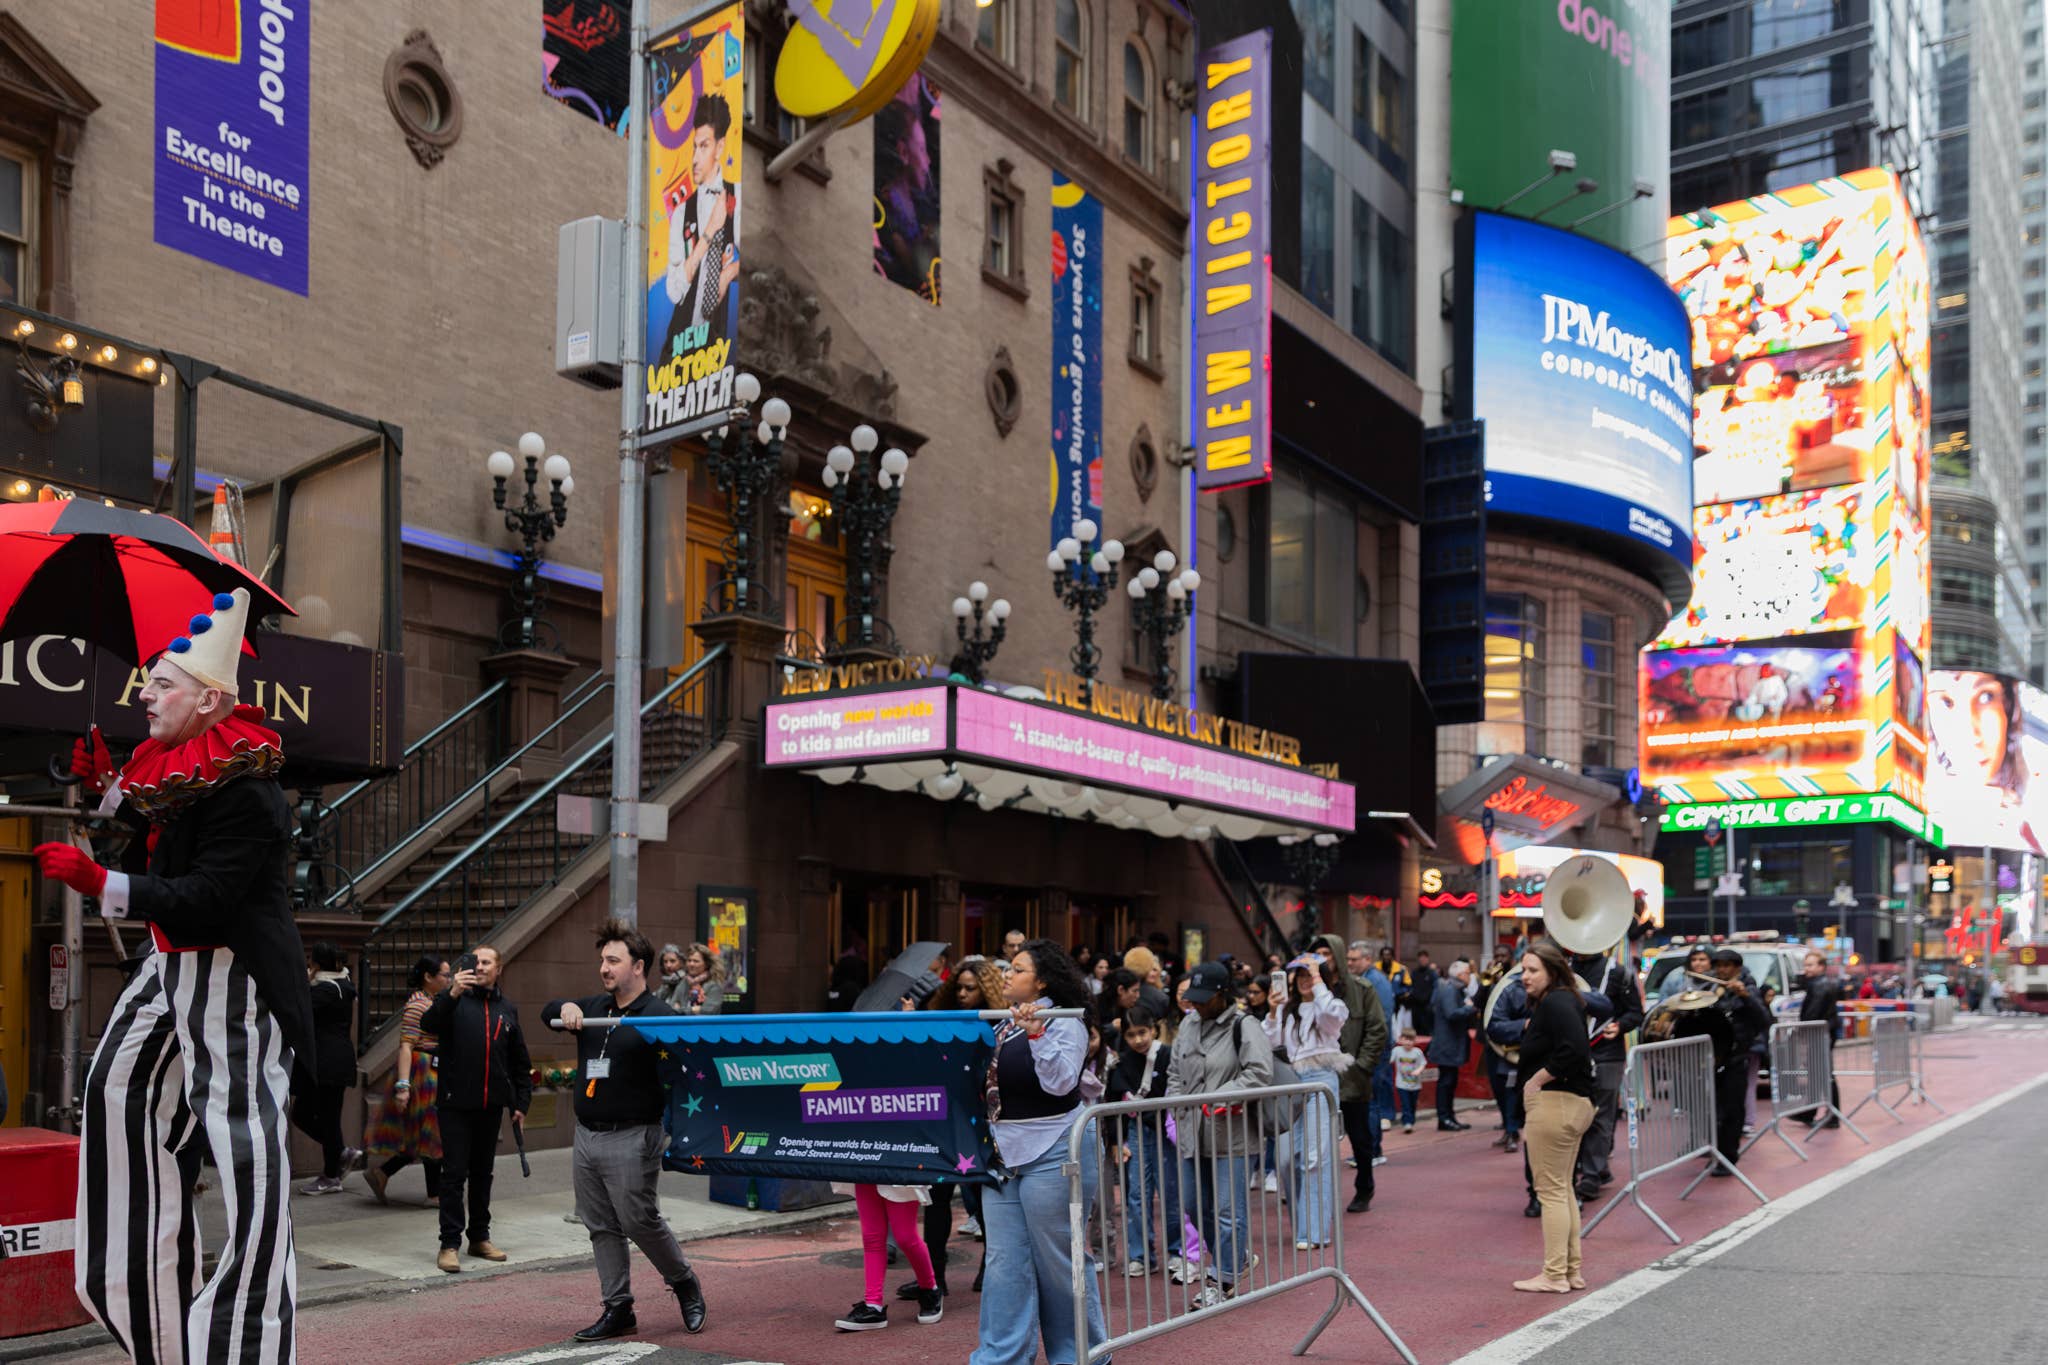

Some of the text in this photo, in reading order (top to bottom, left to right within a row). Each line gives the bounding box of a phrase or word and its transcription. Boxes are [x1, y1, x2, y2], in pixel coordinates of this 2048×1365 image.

[218, 121, 251, 152] for
[166, 126, 300, 203] Excellence
[203, 176, 265, 219] in the
[182, 195, 283, 256] Theatre
[1072, 223, 1086, 259] 30
[1206, 56, 1252, 471] NEW VICTORY
[1070, 258, 1083, 330] years
[672, 320, 710, 358] NEW
[1072, 334, 1086, 365] of
[647, 337, 731, 396] VICTORY
[1541, 350, 1646, 401] CORPORATE
[646, 365, 735, 430] THEATER
[1069, 362, 1085, 465] growing
[115, 667, 311, 724] AIN
[781, 656, 937, 695] NEW VICTORY
[777, 700, 934, 734] Opening new worlds
[1041, 668, 1301, 767] THE NEW VICTORY THEATER
[781, 724, 930, 754] to kids and families
[1027, 729, 1125, 764] standard-bearer
[1126, 749, 1139, 767] of
[1140, 755, 1178, 781] quality
[1675, 803, 1780, 828] CRYSTAL
[1784, 799, 1844, 823] GIFT
[806, 1093, 941, 1116] FAMILY BENEFIT
[779, 1136, 813, 1149] Opening
[832, 1139, 859, 1149] worlds
[860, 1140, 873, 1149] for
[873, 1141, 891, 1151] kids
[892, 1143, 908, 1152] and
[909, 1143, 939, 1154] families
[787, 1149, 807, 1157] 42nd
[808, 1149, 833, 1158] Street
[833, 1151, 850, 1159] and
[849, 1151, 882, 1161] beyond
